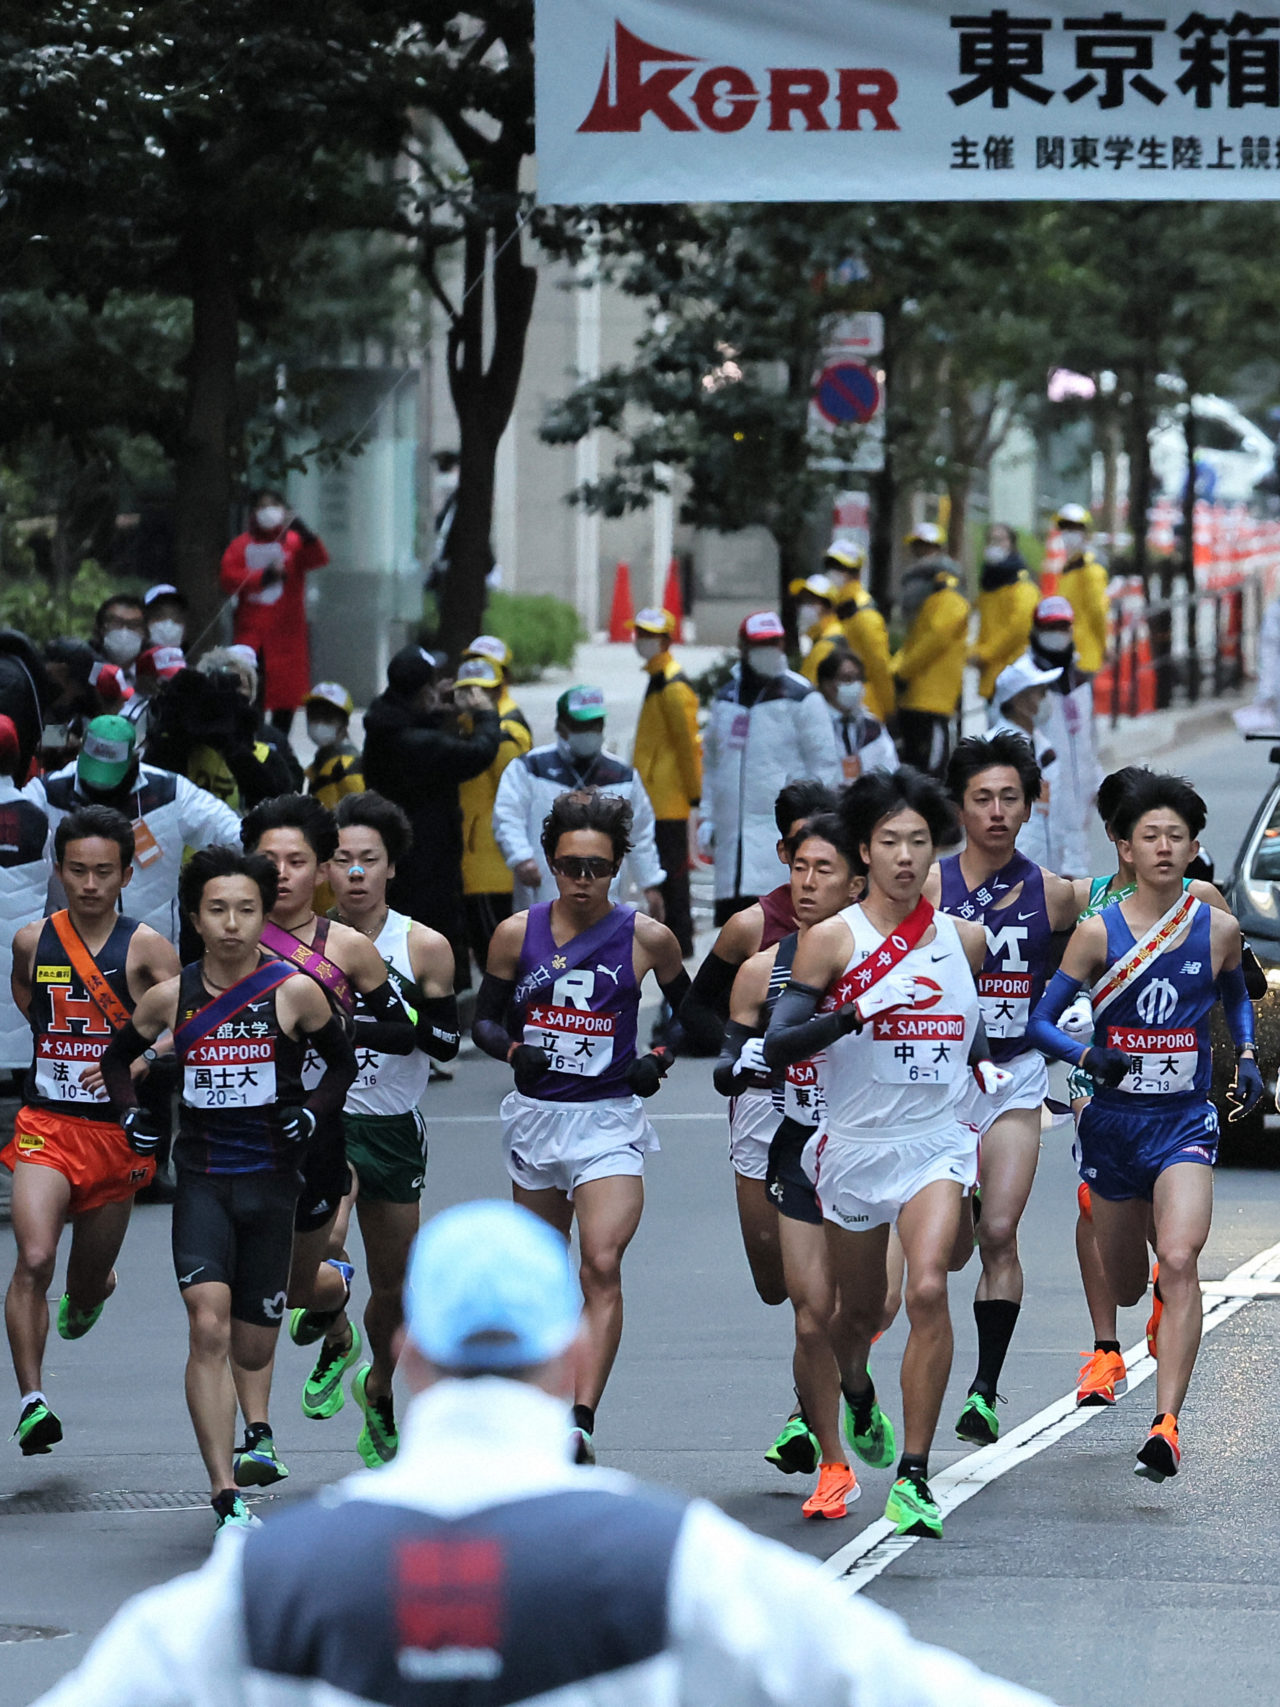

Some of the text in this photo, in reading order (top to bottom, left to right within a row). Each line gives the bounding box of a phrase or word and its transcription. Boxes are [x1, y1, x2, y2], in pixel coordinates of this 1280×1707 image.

[950, 136, 1014, 170] 主催
[552, 969, 595, 1012] R
[47, 984, 111, 1034] H
[546, 1011, 612, 1032] SAPPORO
[896, 1020, 963, 1036] SAPPORO
[1126, 1032, 1195, 1049] SAPPORO
[200, 1043, 271, 1061] SAPPORO
[894, 1042, 951, 1065] 中大
[548, 1053, 586, 1073] 16-1
[909, 1065, 940, 1081] 6-1
[194, 1066, 258, 1089] 国士大
[1133, 1076, 1170, 1092] 2-13
[206, 1090, 248, 1106] 20-1
